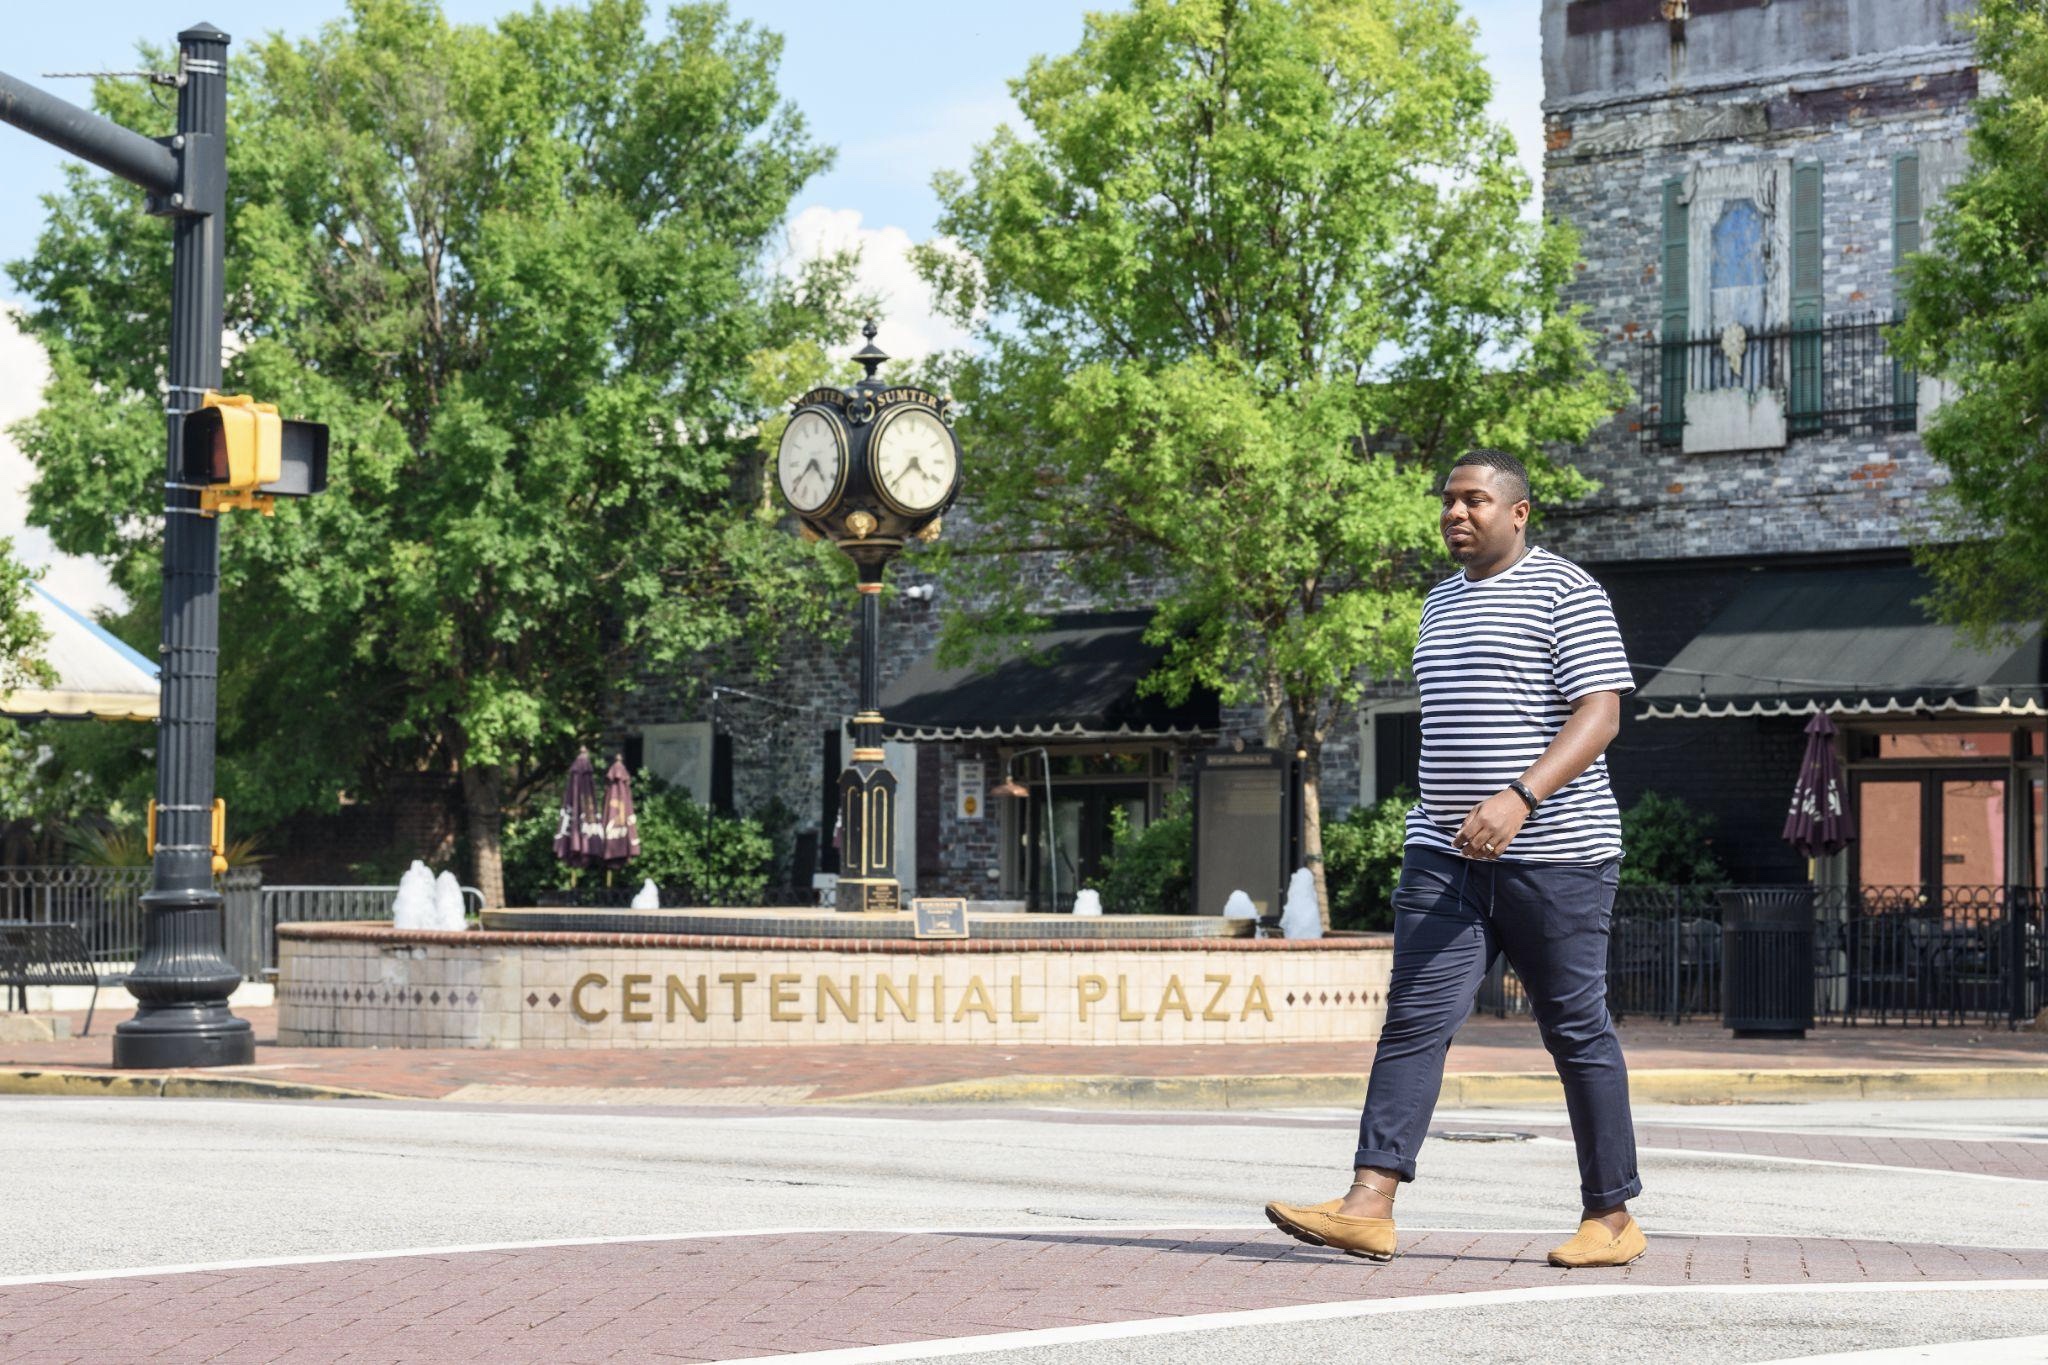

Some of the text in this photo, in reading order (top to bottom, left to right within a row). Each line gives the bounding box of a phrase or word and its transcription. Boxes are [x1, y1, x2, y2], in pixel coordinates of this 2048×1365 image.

[798, 389, 846, 406] SUMTER
[876, 389, 938, 409] SUMTER
[571, 972, 1275, 1023] CENTENNIAL PLAZA
